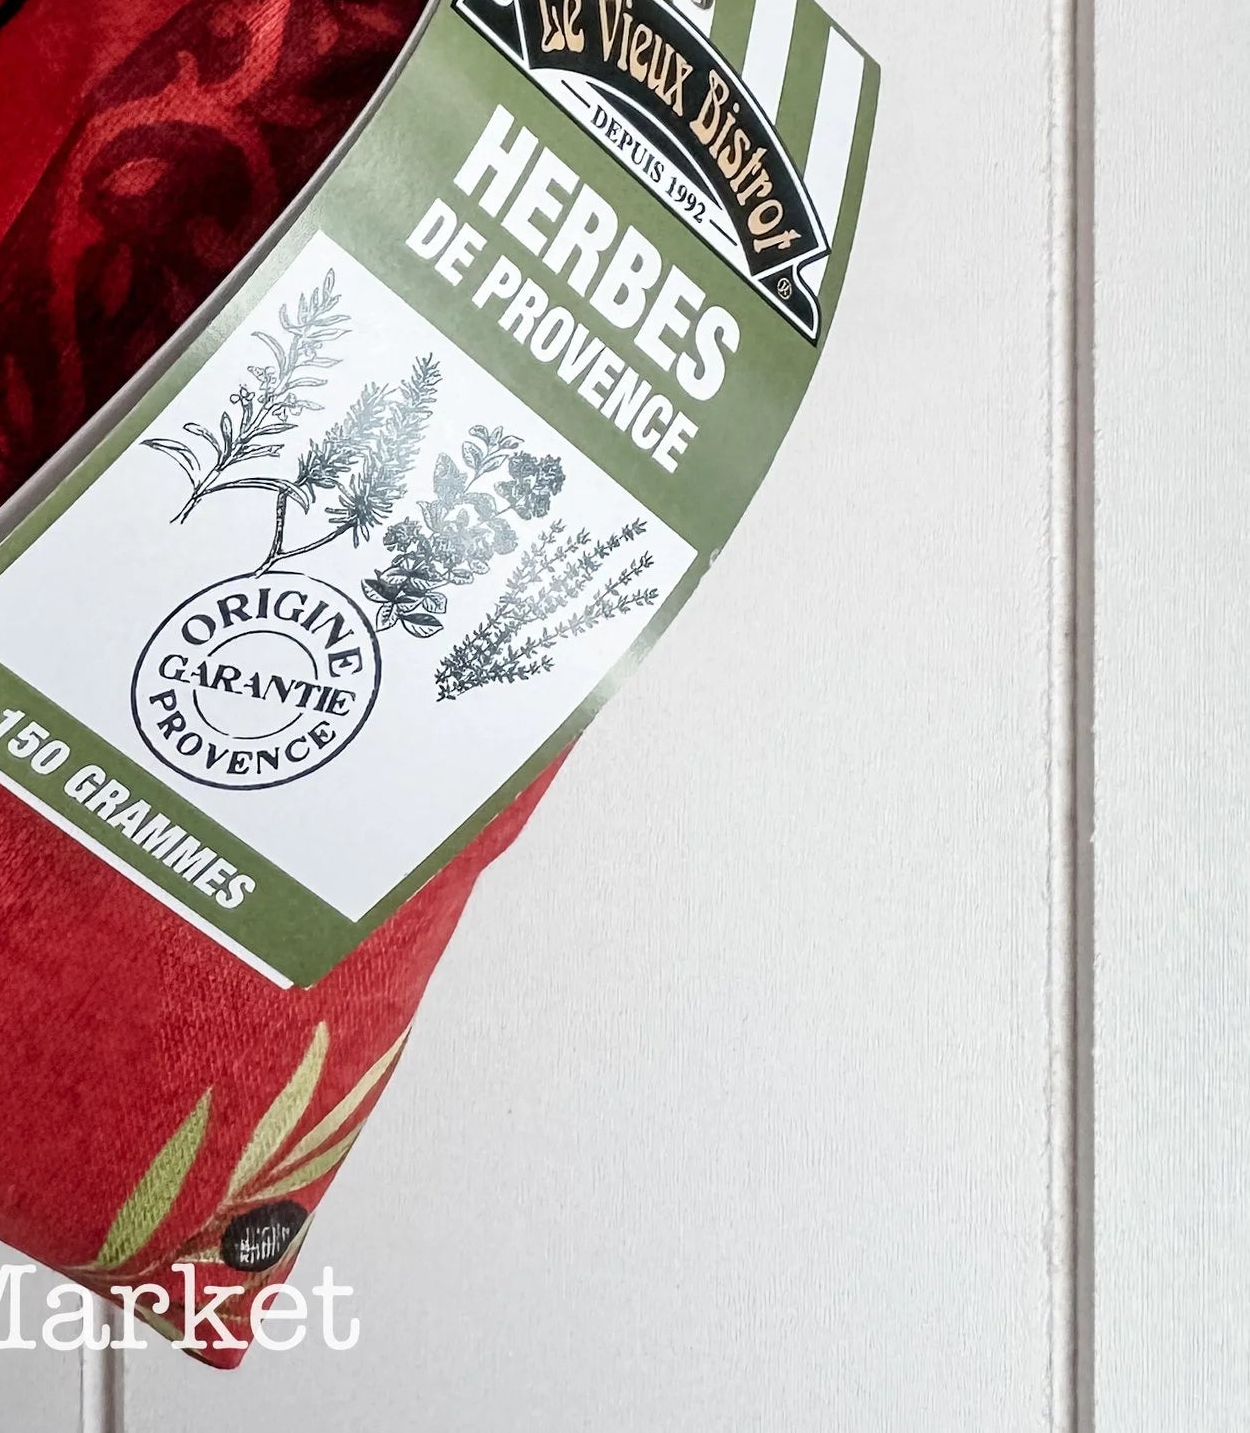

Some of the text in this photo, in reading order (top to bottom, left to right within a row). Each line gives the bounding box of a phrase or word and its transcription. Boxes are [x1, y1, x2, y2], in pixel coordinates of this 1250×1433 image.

[589, 104, 707, 225] DEPUIS 1992
[689, 70, 802, 254] Bistrot
[453, 104, 741, 402] HERBES
[405, 197, 700, 474] DE PROVENCE
[158, 654, 356, 716] GARANTIE
[181, 588, 363, 678] ORIGINE
[149, 689, 336, 776] PROVENCE
[63, 764, 256, 910] GRAMMES
